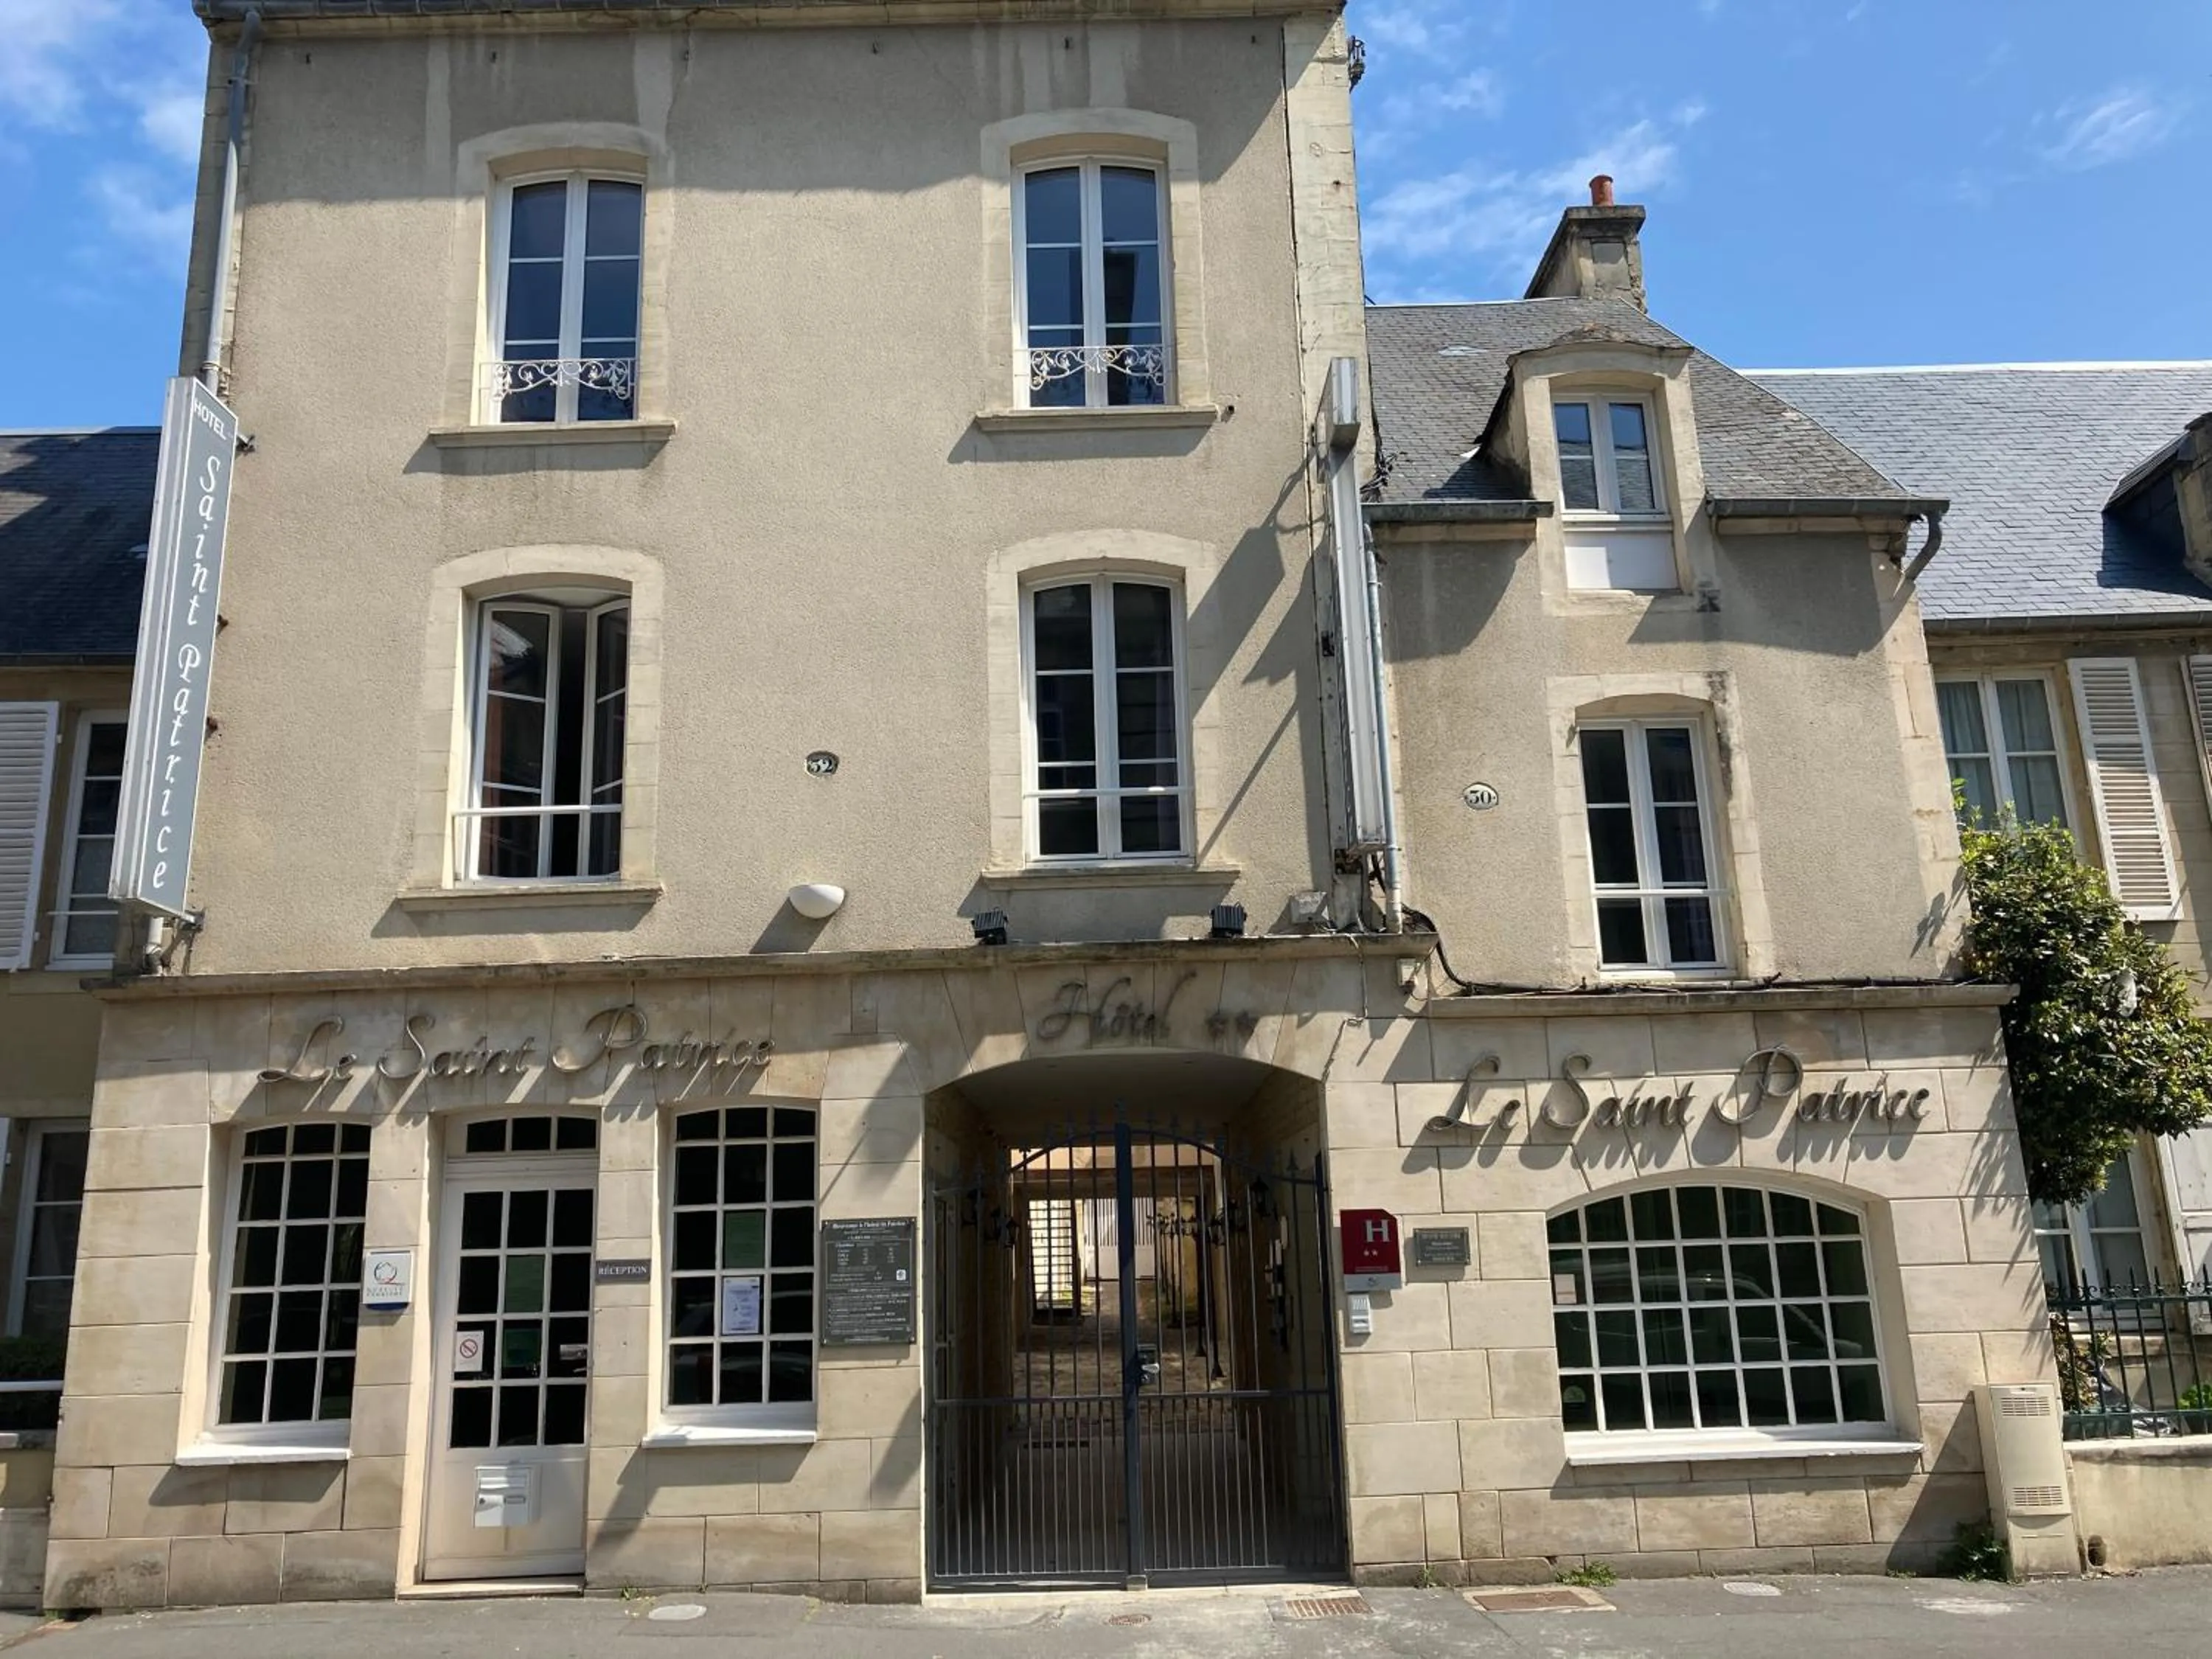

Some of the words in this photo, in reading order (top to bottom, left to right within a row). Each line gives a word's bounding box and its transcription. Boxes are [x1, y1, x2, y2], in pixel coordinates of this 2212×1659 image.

[194, 397, 226, 440] HOTEL
[185, 454, 220, 626] Saint
[153, 642, 201, 888] Patrice
[1468, 789, 1492, 804] 50
[257, 1015, 358, 1084] Le
[378, 1014, 535, 1079] Saint
[552, 1004, 776, 1072] Patrice
[1427, 1054, 1522, 1132] Le
[1541, 1052, 1697, 1130] Saint
[1714, 1043, 1931, 1125] Patrice
[1366, 1219, 1391, 1242] H
